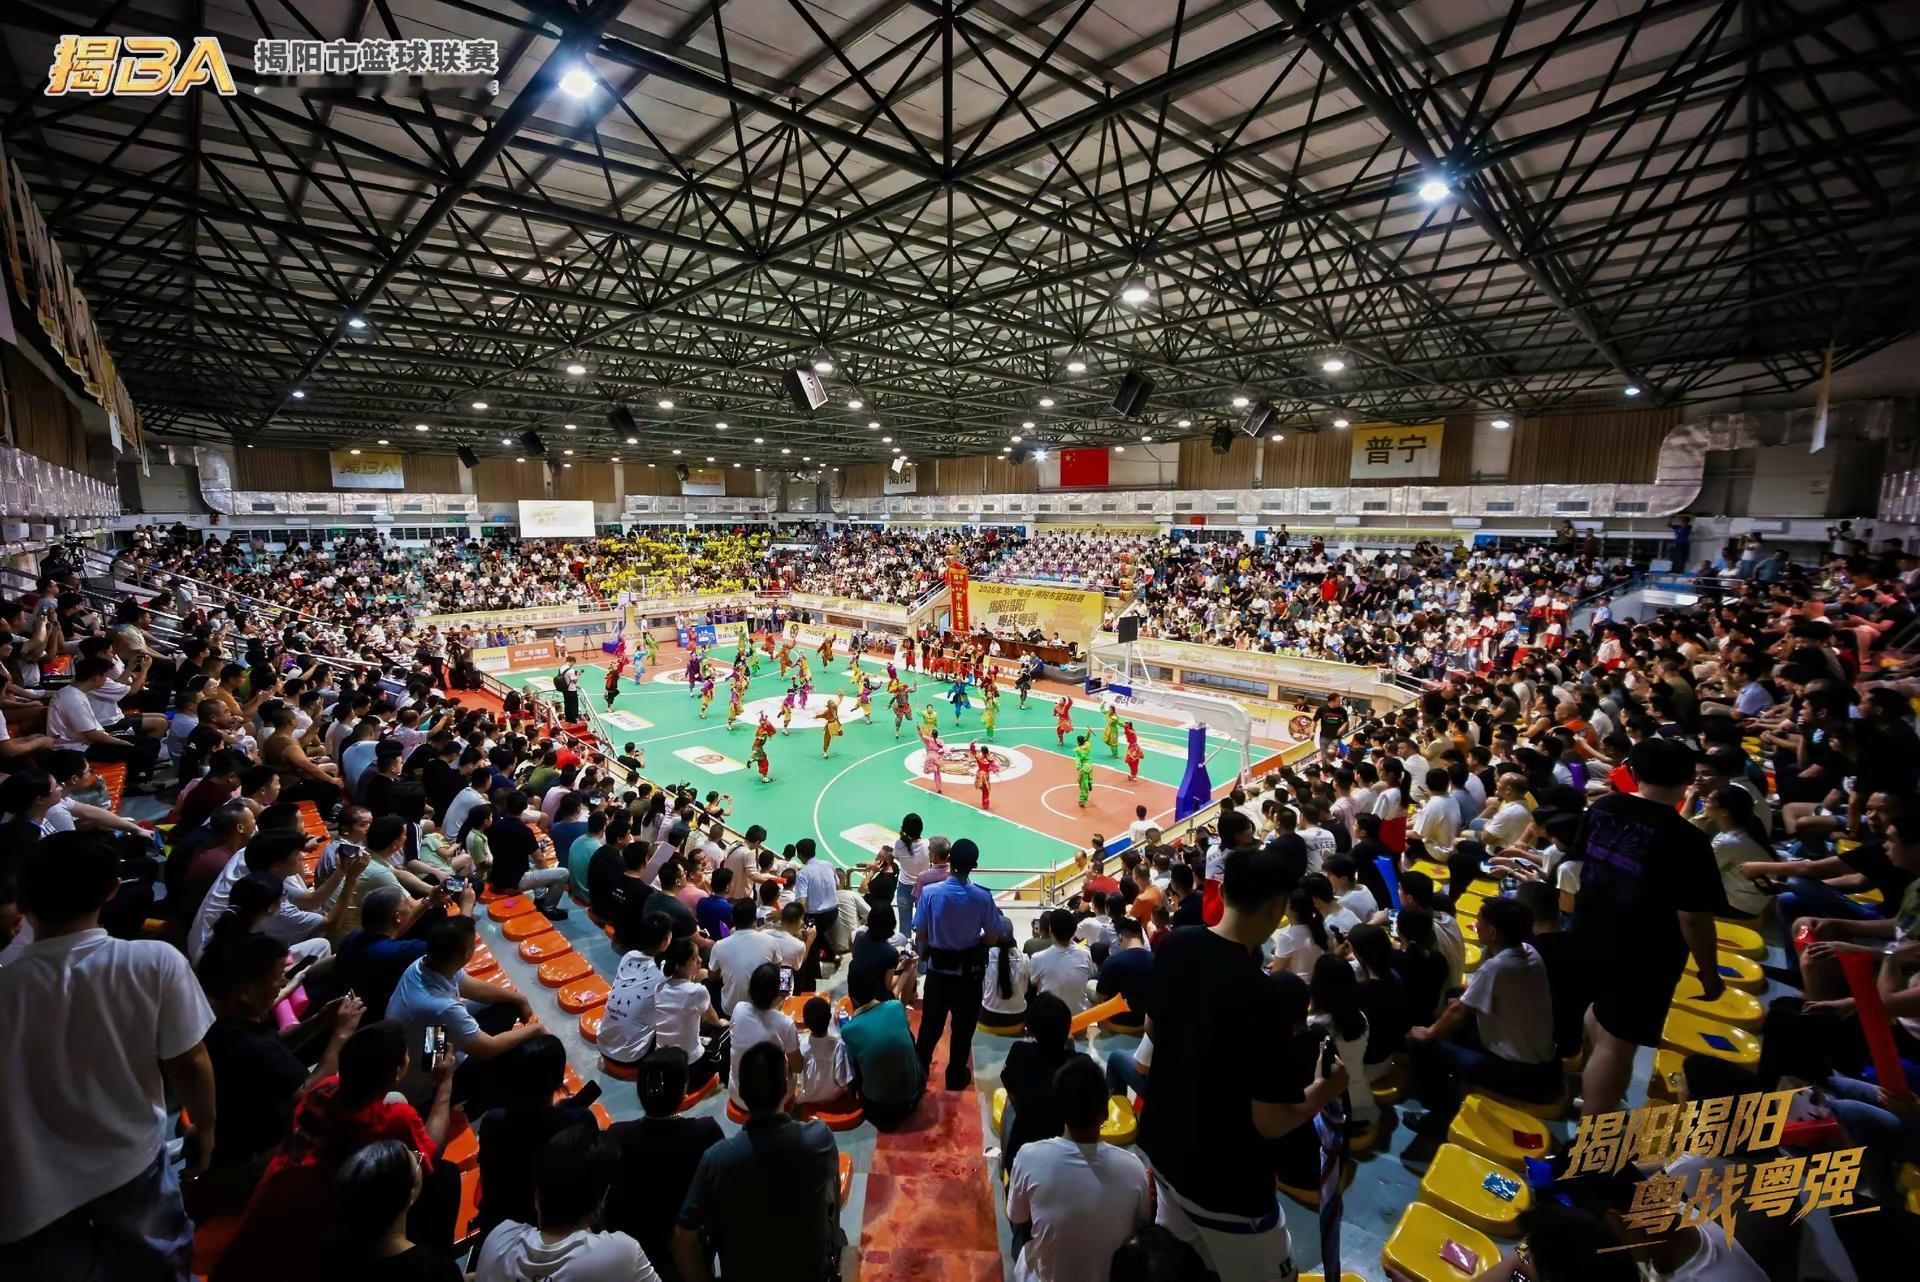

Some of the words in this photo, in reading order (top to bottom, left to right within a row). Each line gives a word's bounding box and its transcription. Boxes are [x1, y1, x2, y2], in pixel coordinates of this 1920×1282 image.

[1365, 434, 1427, 465] 普宁
[987, 598, 1027, 614] 揭阳揭阳
